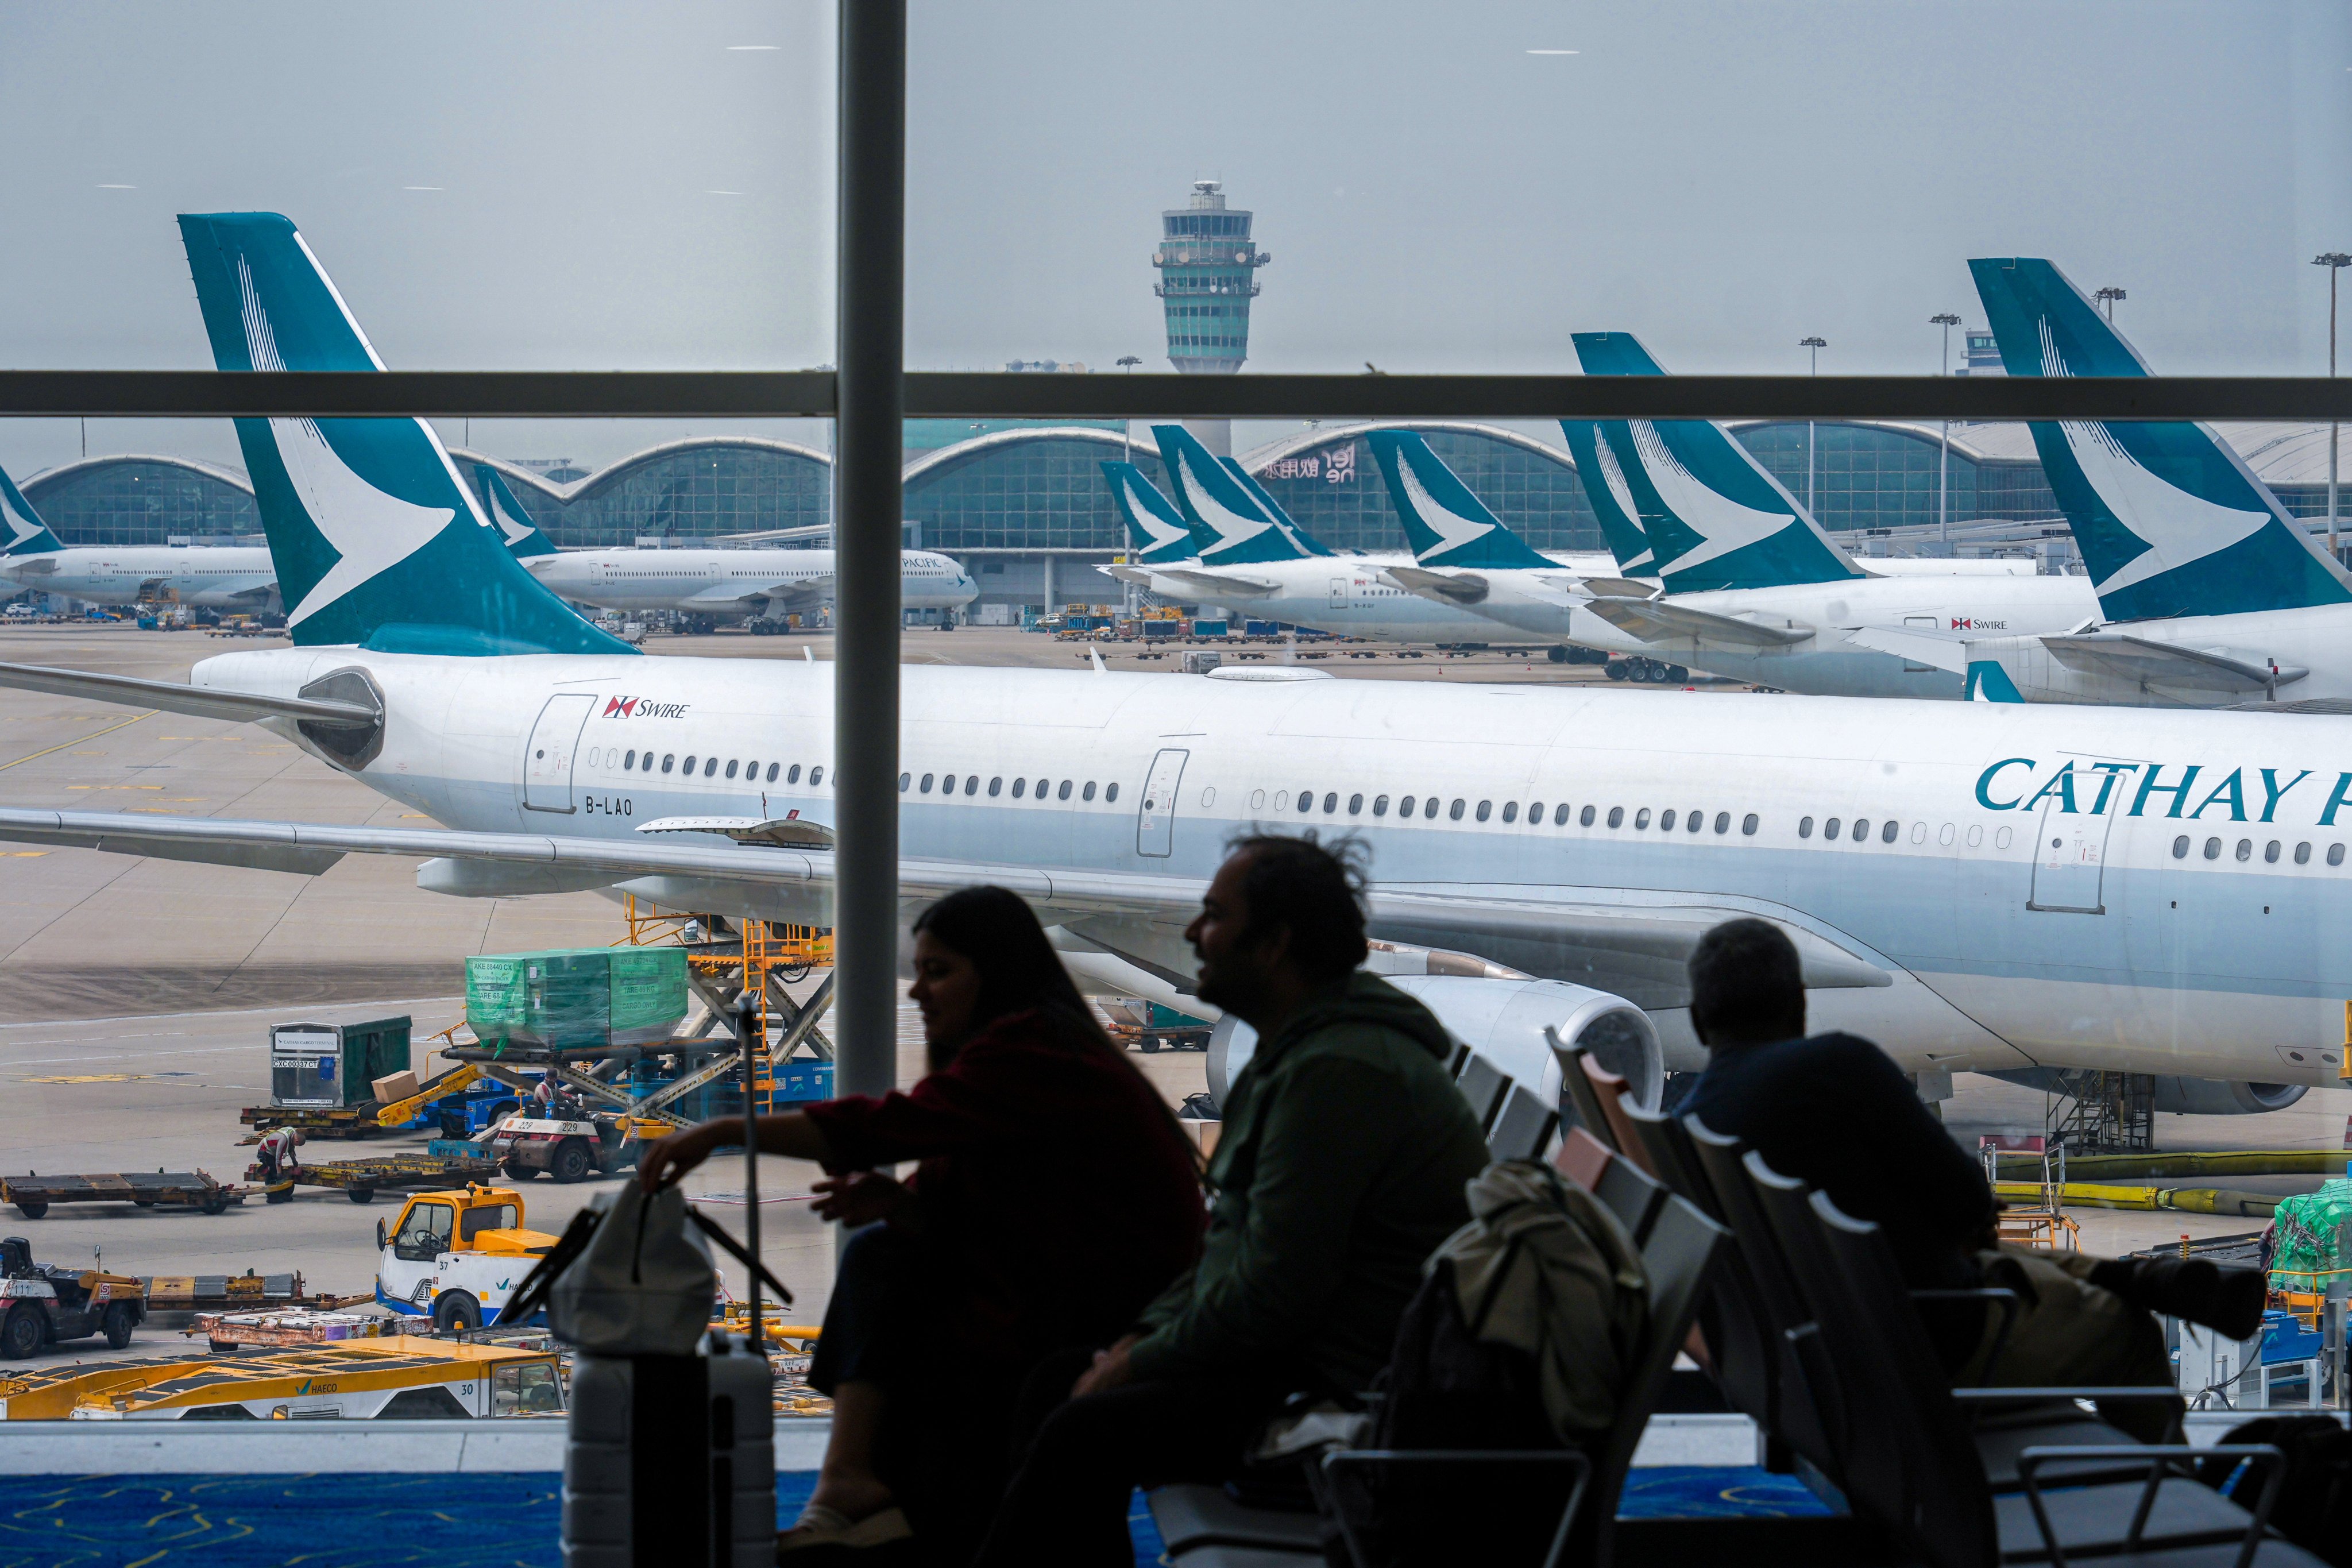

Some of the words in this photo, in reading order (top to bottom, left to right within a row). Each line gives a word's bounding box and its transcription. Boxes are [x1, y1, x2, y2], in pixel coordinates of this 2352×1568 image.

[902, 558, 942, 567] PACIFIC
[1973, 619, 2008, 629] SWIRE
[635, 700, 690, 719] SWIRE
[1975, 757, 2316, 823] CATHAY
[518, 1121, 533, 1129] 229
[562, 1123, 577, 1132] 229
[439, 1261, 449, 1270] 37
[15, 1285, 29, 1295] 111
[311, 1383, 338, 1394] HAECO
[461, 1384, 473, 1396] 30
